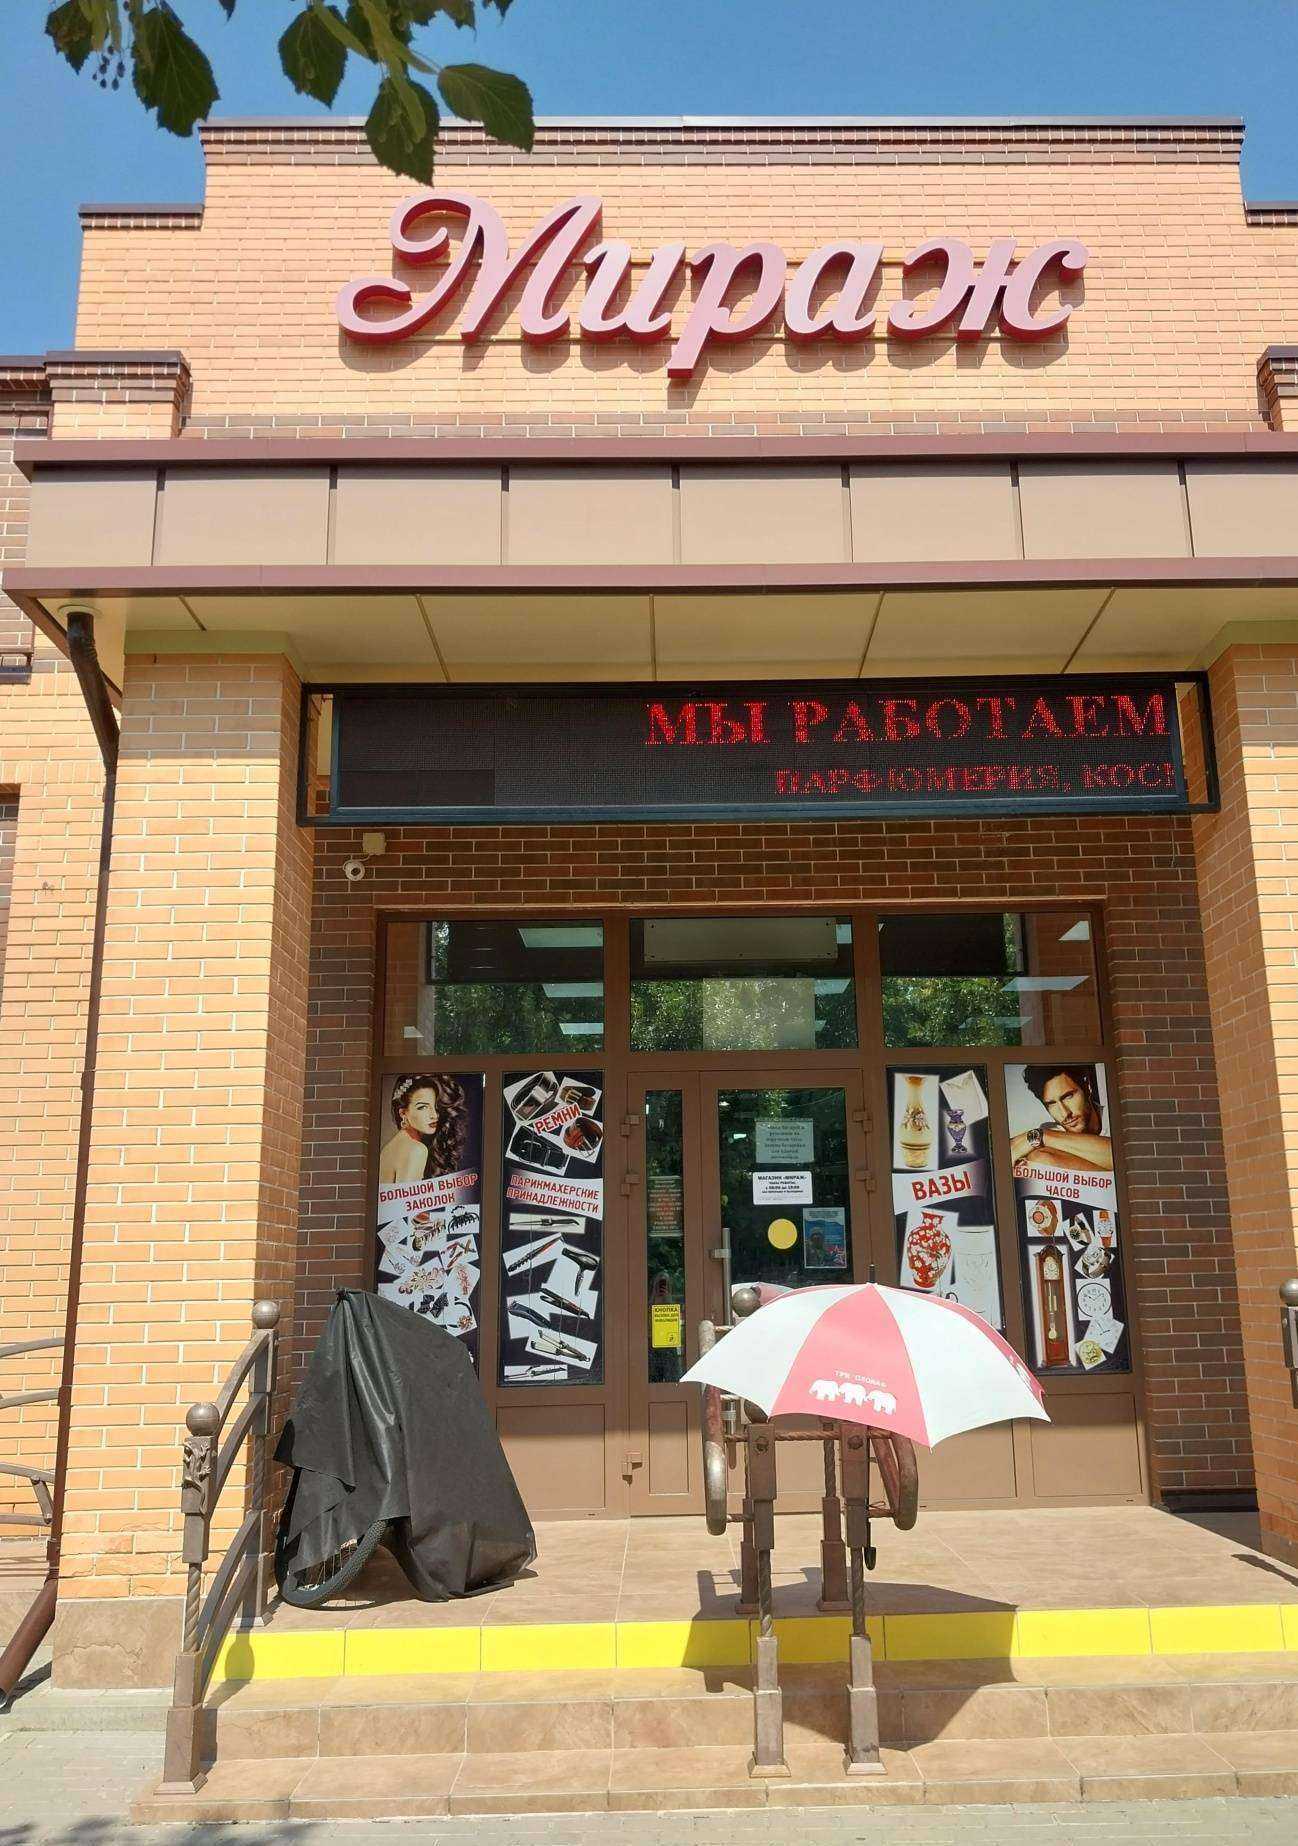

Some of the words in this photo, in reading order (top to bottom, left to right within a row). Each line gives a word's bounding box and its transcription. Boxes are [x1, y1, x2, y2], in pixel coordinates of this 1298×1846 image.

[336, 193, 1088, 379] Мираж
[645, 702, 772, 744] МЫ
[788, 694, 1171, 744] РАБОТАЕМ
[534, 1103, 581, 1134] РЕМНИ
[379, 1182, 435, 1203] БОЛЬШОЙ
[438, 1173, 478, 1191] ВЫБОР
[511, 1175, 600, 1200] ПАРИКМАХЕРСКИЕ
[911, 1170, 972, 1201] ВАЗЫ
[1014, 1165, 1069, 1184] БОЛЬШОЙ
[1073, 1174, 1112, 1190] ВЫБОР
[405, 1192, 455, 1212] ЗАКОЛОК
[507, 1187, 599, 1213] ПРИНАДЛЕЖНОСТИ
[1045, 1185, 1080, 1199] ЧАСОВ
